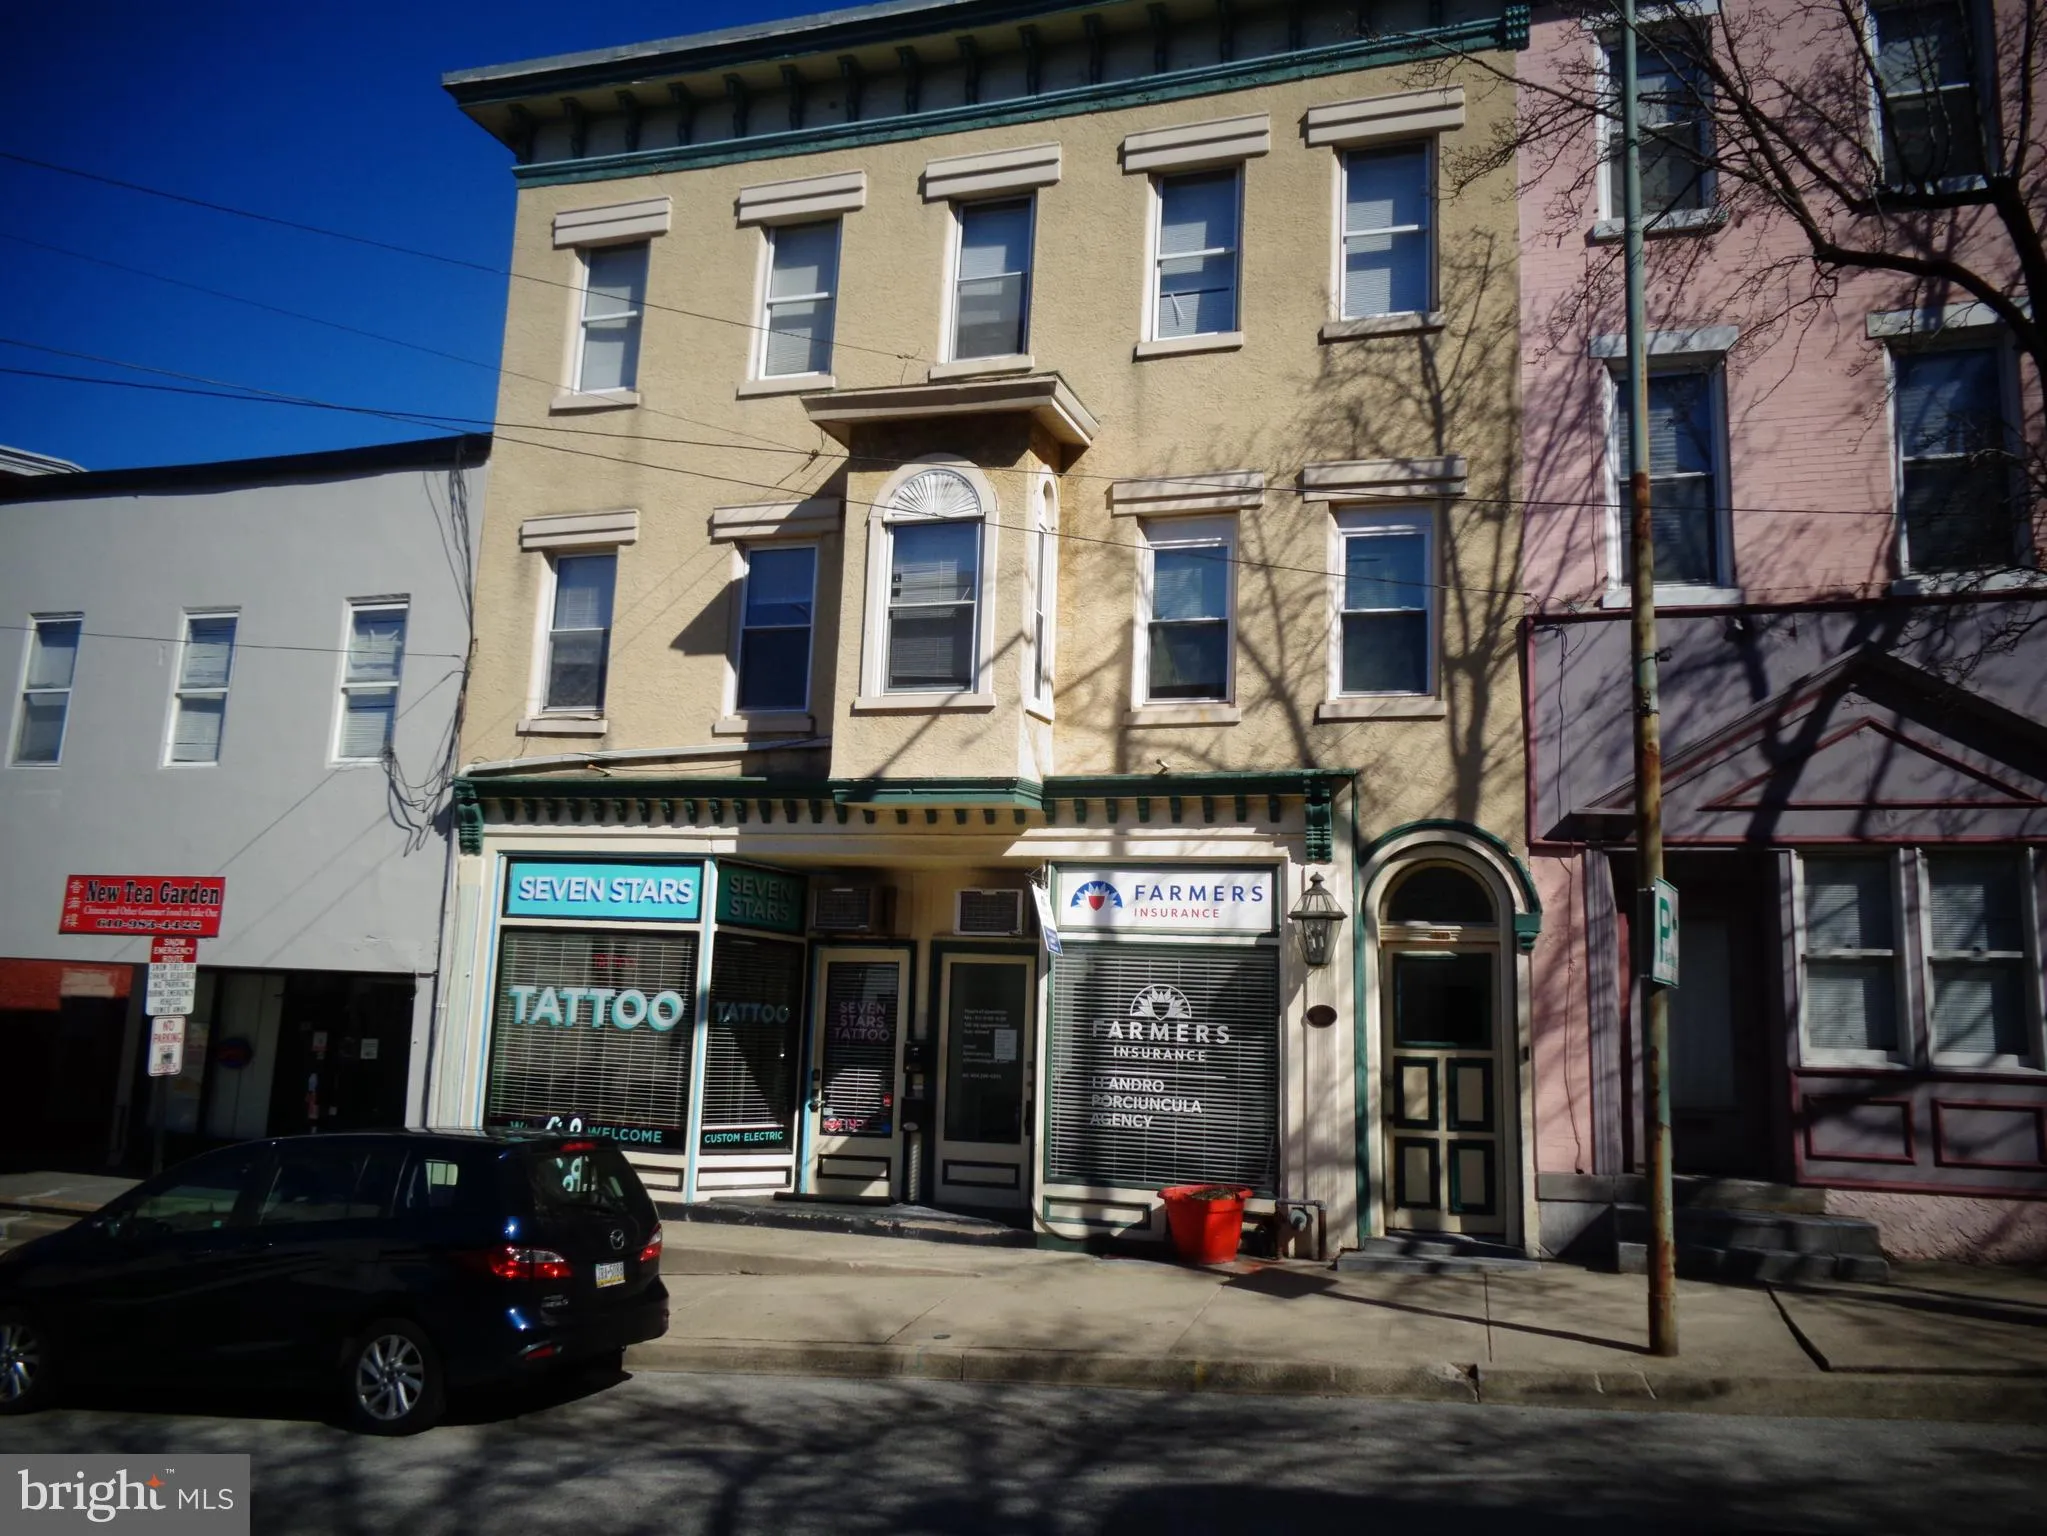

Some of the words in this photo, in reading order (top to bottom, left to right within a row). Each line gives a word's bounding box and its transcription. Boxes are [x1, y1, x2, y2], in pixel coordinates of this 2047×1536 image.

[86, 880, 119, 903] New
[125, 880, 153, 904] Tea
[160, 881, 220, 905] Garden
[518, 876, 604, 902] SEVEN
[609, 878, 694, 904] STARS
[728, 873, 793, 901] SEVEN
[1134, 884, 1263, 902] FARMERS
[728, 897, 790, 922] STARS
[1133, 907, 1220, 919] INSURANCE
[508, 985, 685, 1031] TATTOO
[714, 1001, 791, 1024] TATTOO
[839, 1001, 887, 1015] SEVEN
[839, 1014, 885, 1028] STARS
[834, 1027, 890, 1042] TATTOO
[1092, 1020, 1230, 1044] FARMERS
[1113, 1046, 1206, 1061] INSURANCE
[1091, 1094, 1202, 1114] PORCIUNCULA
[1090, 1113, 1153, 1128] AGENCY
[587, 1126, 663, 1143] WELCOME
[704, 1133, 740, 1144] CUSTOM
[743, 1130, 783, 1142] ELECTRIC
